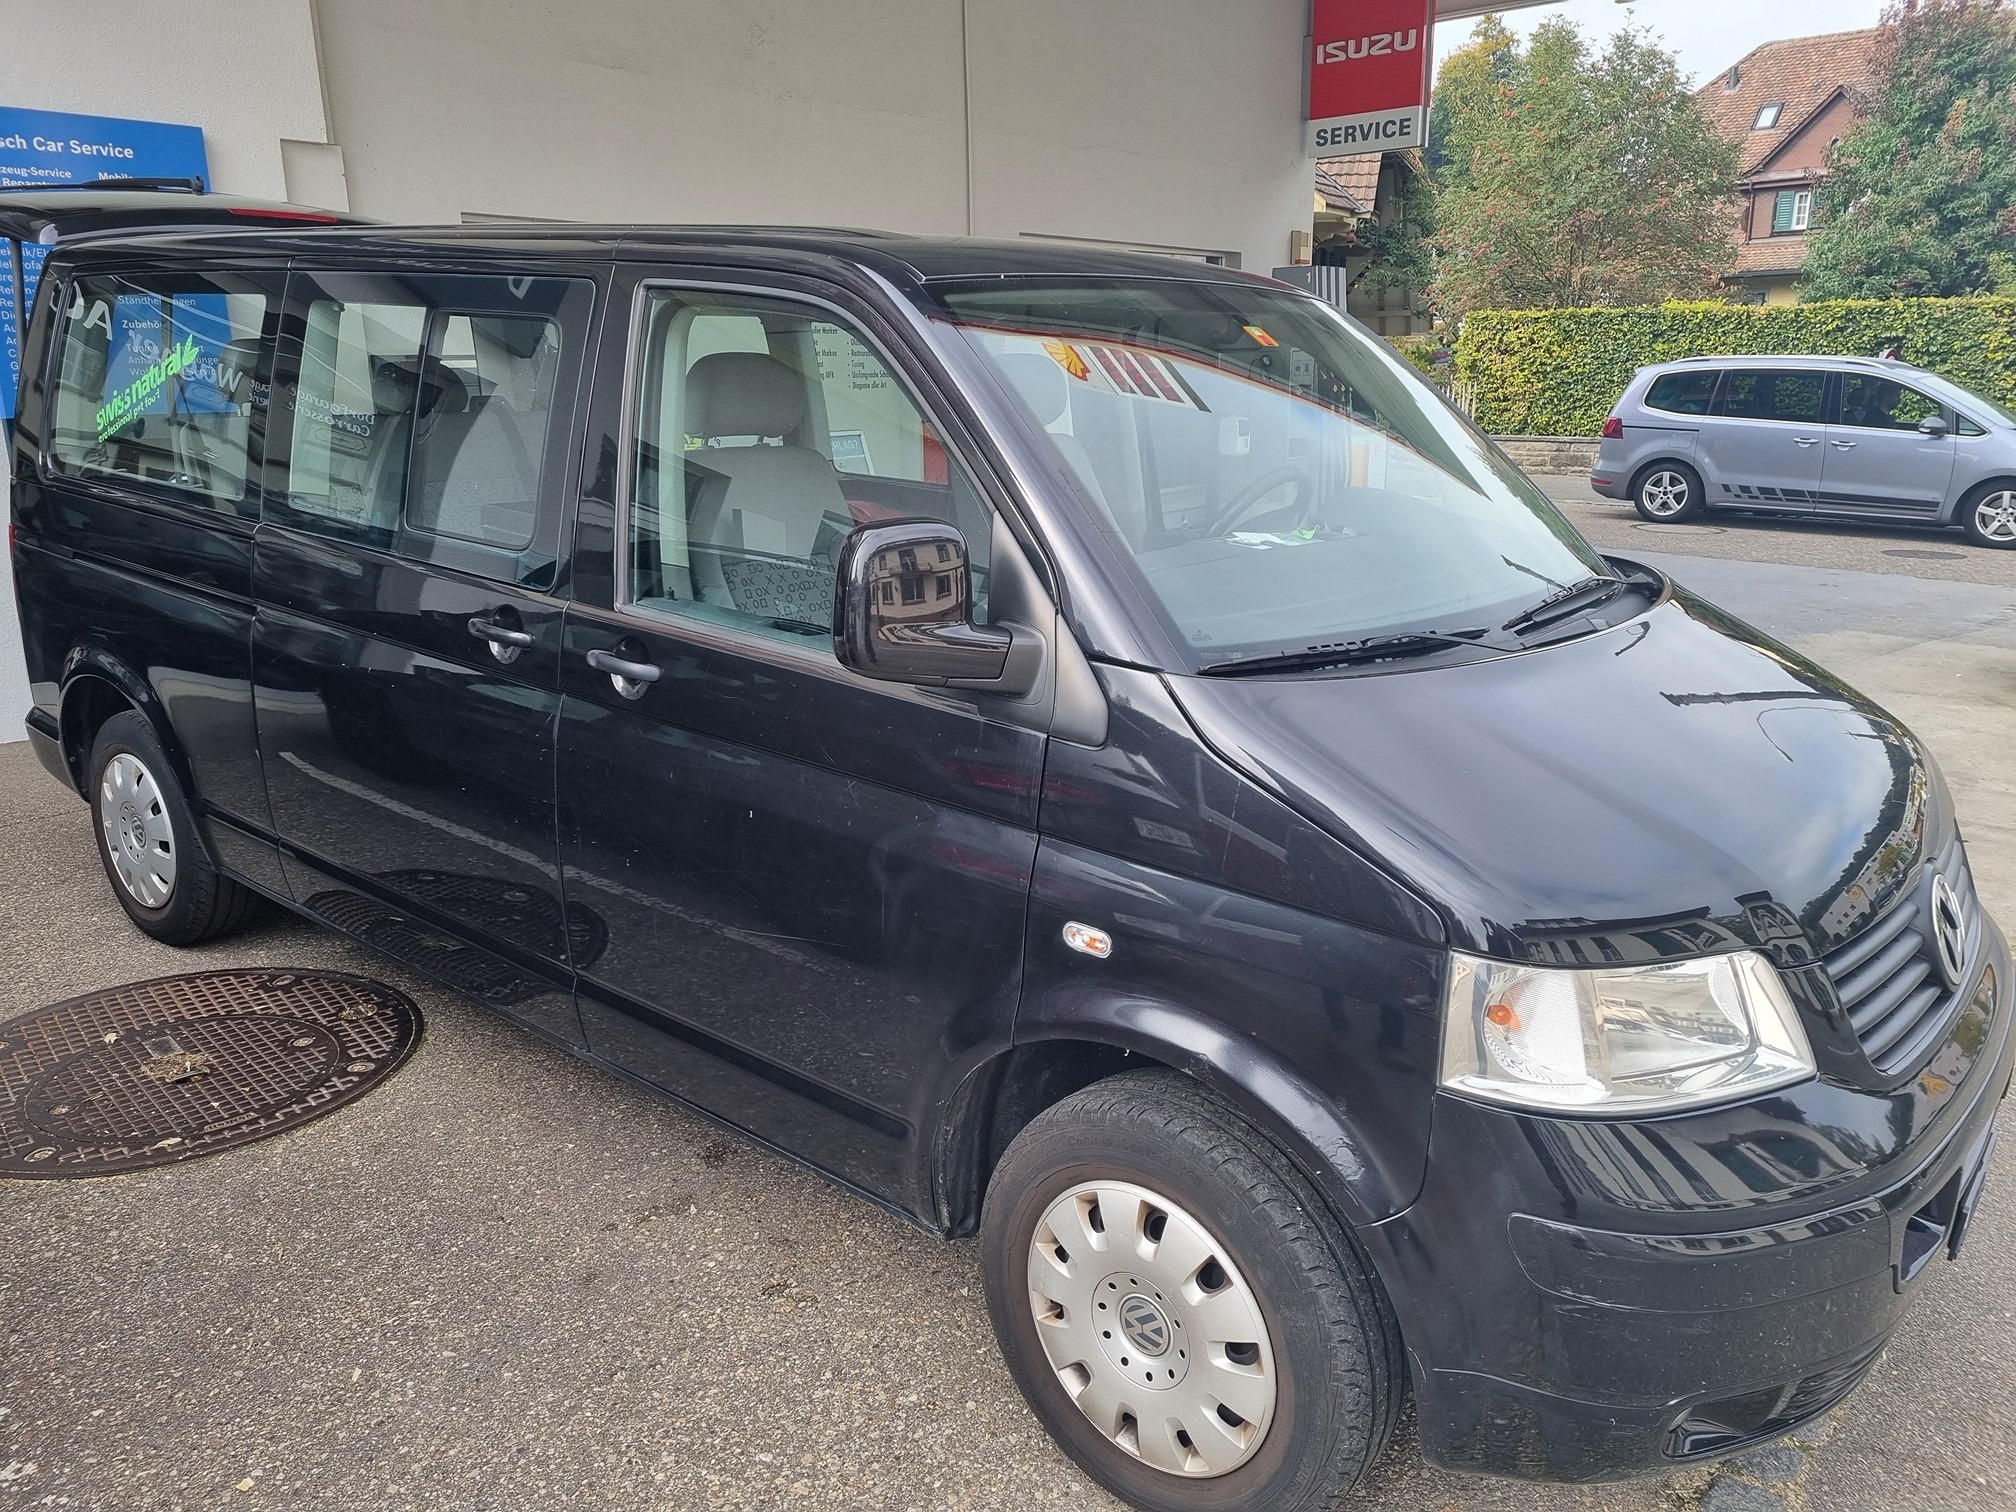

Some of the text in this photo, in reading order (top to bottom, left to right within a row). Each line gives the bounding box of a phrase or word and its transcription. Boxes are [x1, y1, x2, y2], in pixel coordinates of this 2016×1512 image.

[1316, 29, 1417, 65] ISUZU
[1315, 117, 1412, 147] SERVICE
[33, 136, 64, 152] Car
[70, 140, 134, 158] Service
[1305, 271, 1311, 284] 1
[121, 320, 162, 329] Zubehö
